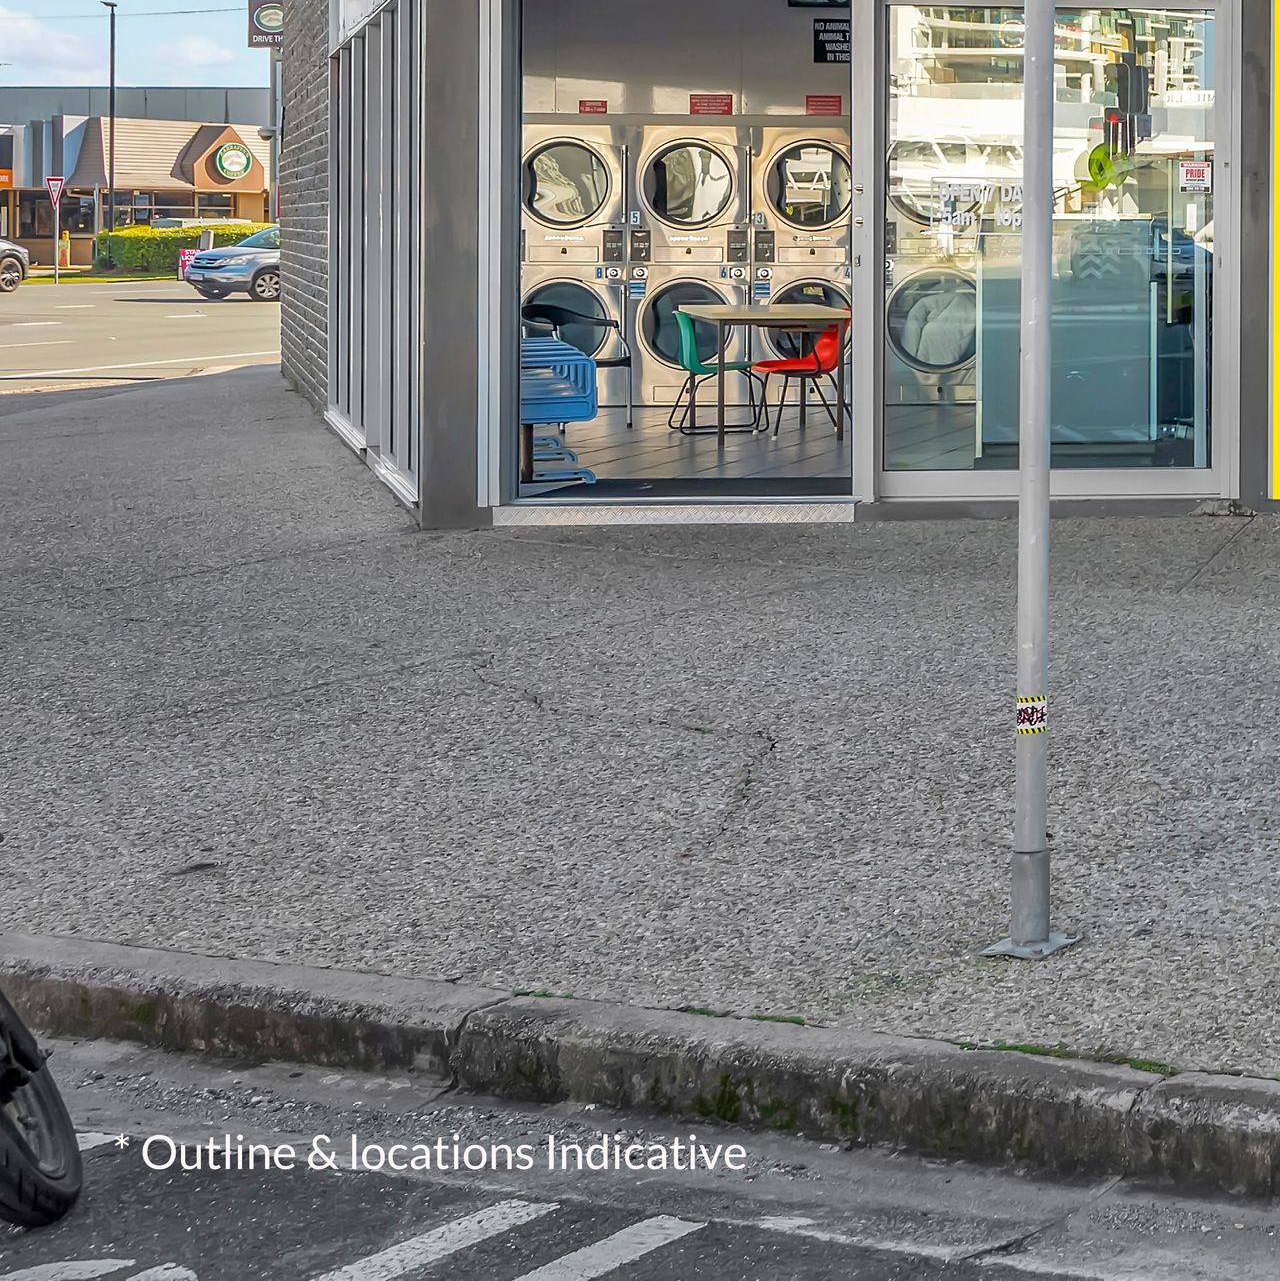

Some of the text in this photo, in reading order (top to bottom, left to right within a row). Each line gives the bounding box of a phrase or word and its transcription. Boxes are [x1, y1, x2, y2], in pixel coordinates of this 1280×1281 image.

[252, 35, 273, 43] DRIVE
[825, 42, 850, 51] WASHE
[1185, 168, 1206, 178] PRIDE
[631, 212, 639, 224] 5
[756, 212, 763, 223] 3
